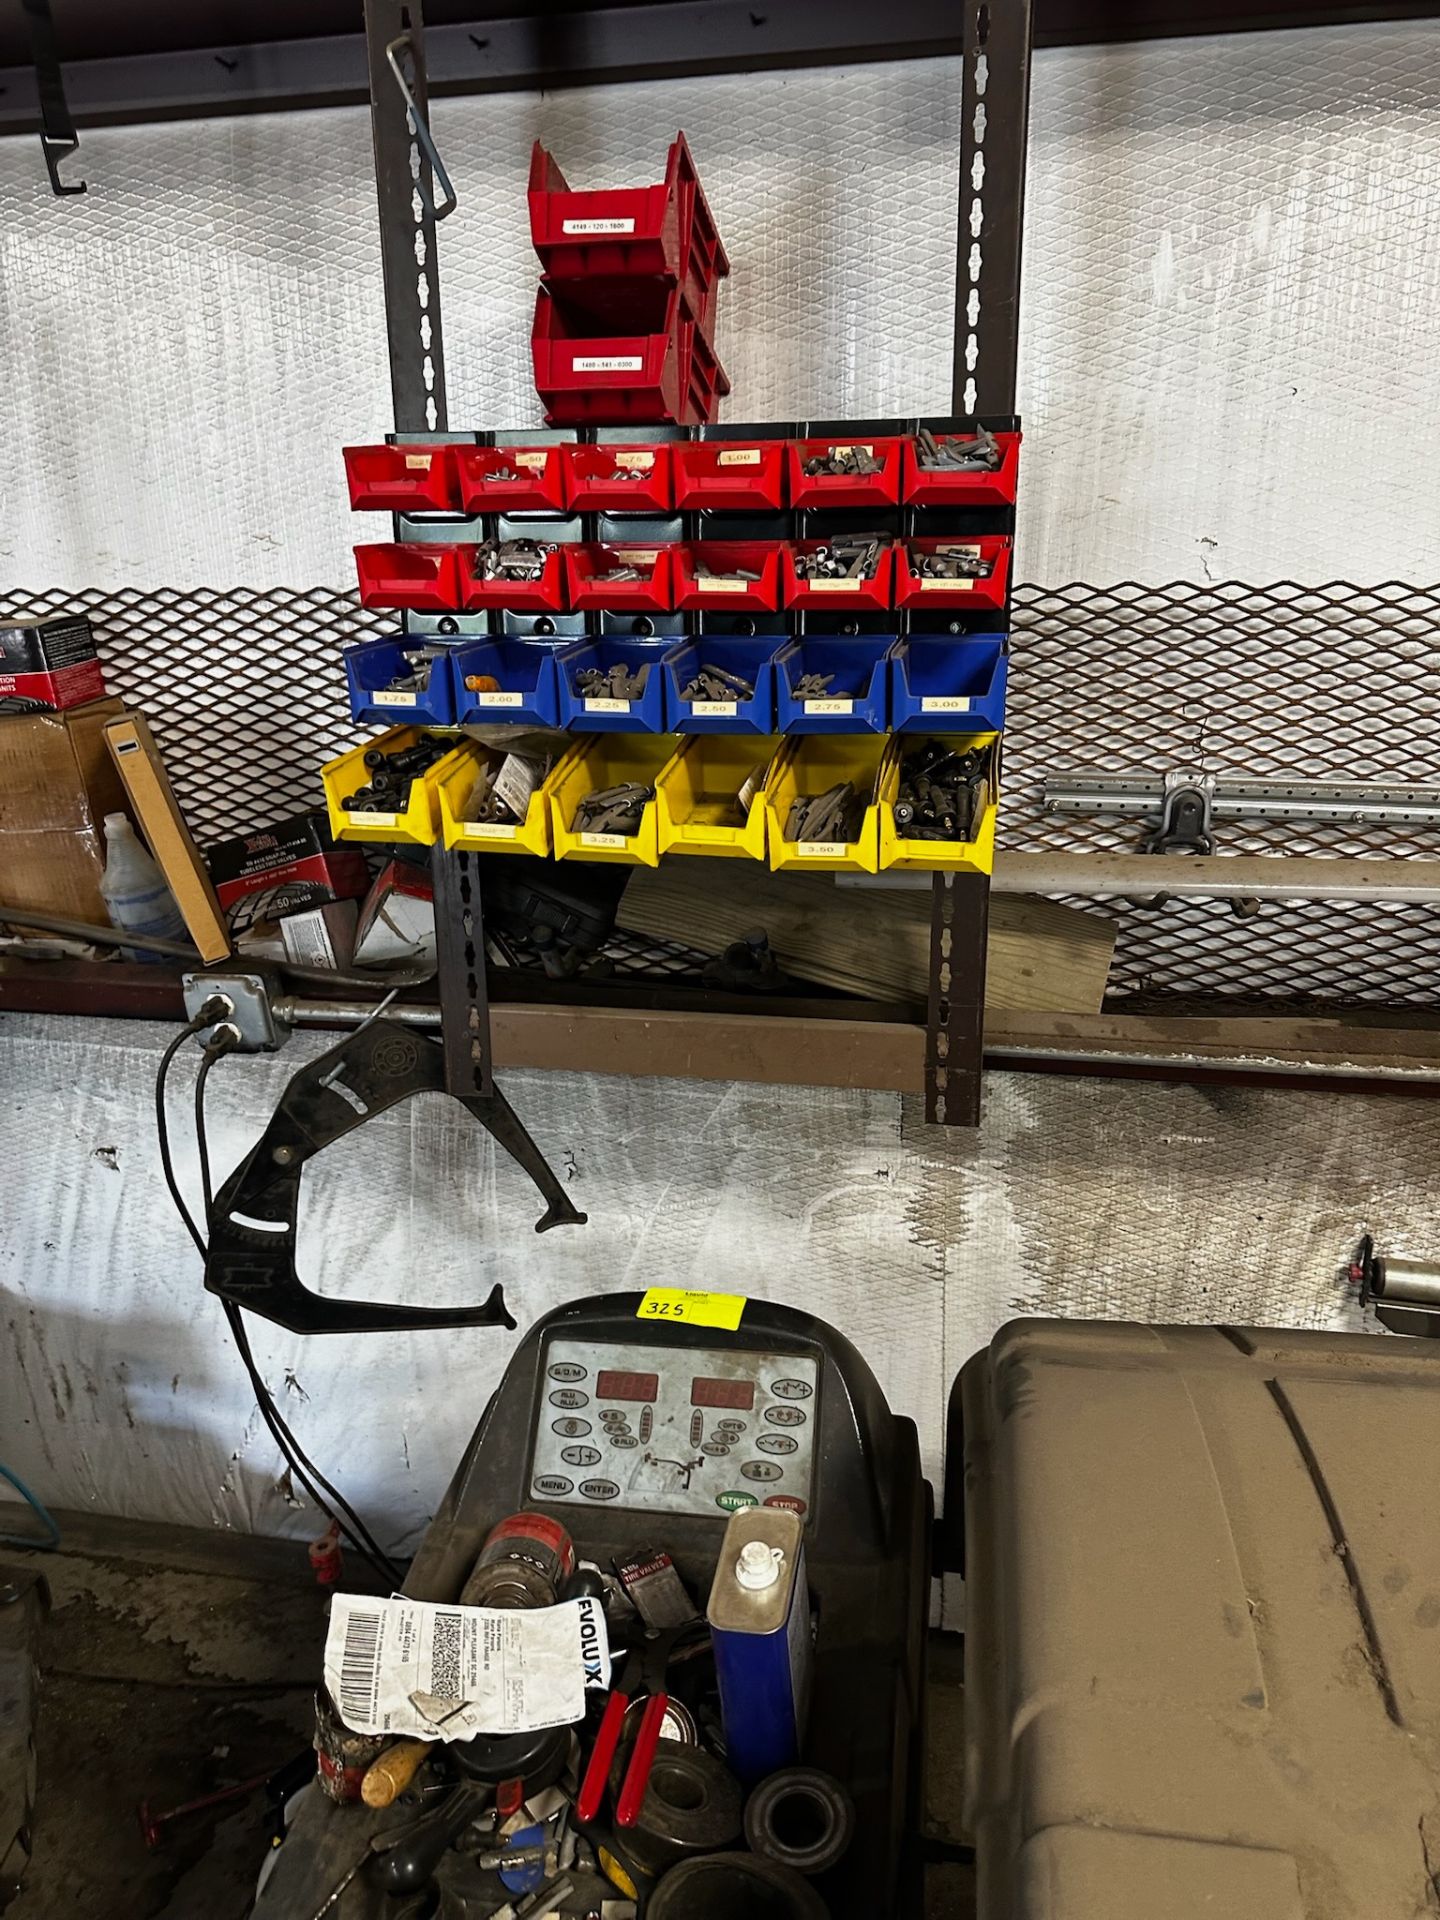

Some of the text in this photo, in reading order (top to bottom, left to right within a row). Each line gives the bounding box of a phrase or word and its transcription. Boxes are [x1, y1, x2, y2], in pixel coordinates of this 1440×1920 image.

[726, 453, 751, 462] 1.00
[383, 695, 407, 703] 1.75
[594, 701, 620, 709] 2.25
[589, 836, 616, 844] 3.25
[277, 853, 297, 864] VALVES
[276, 896, 289, 909] 50
[289, 893, 312, 905] VALVES
[541, 1480, 567, 1490] MENU
[584, 1484, 614, 1494] ENTER
[721, 1496, 753, 1506] START
[624, 1571, 640, 1583] TIRE
[639, 1560, 665, 1576] VALVES
